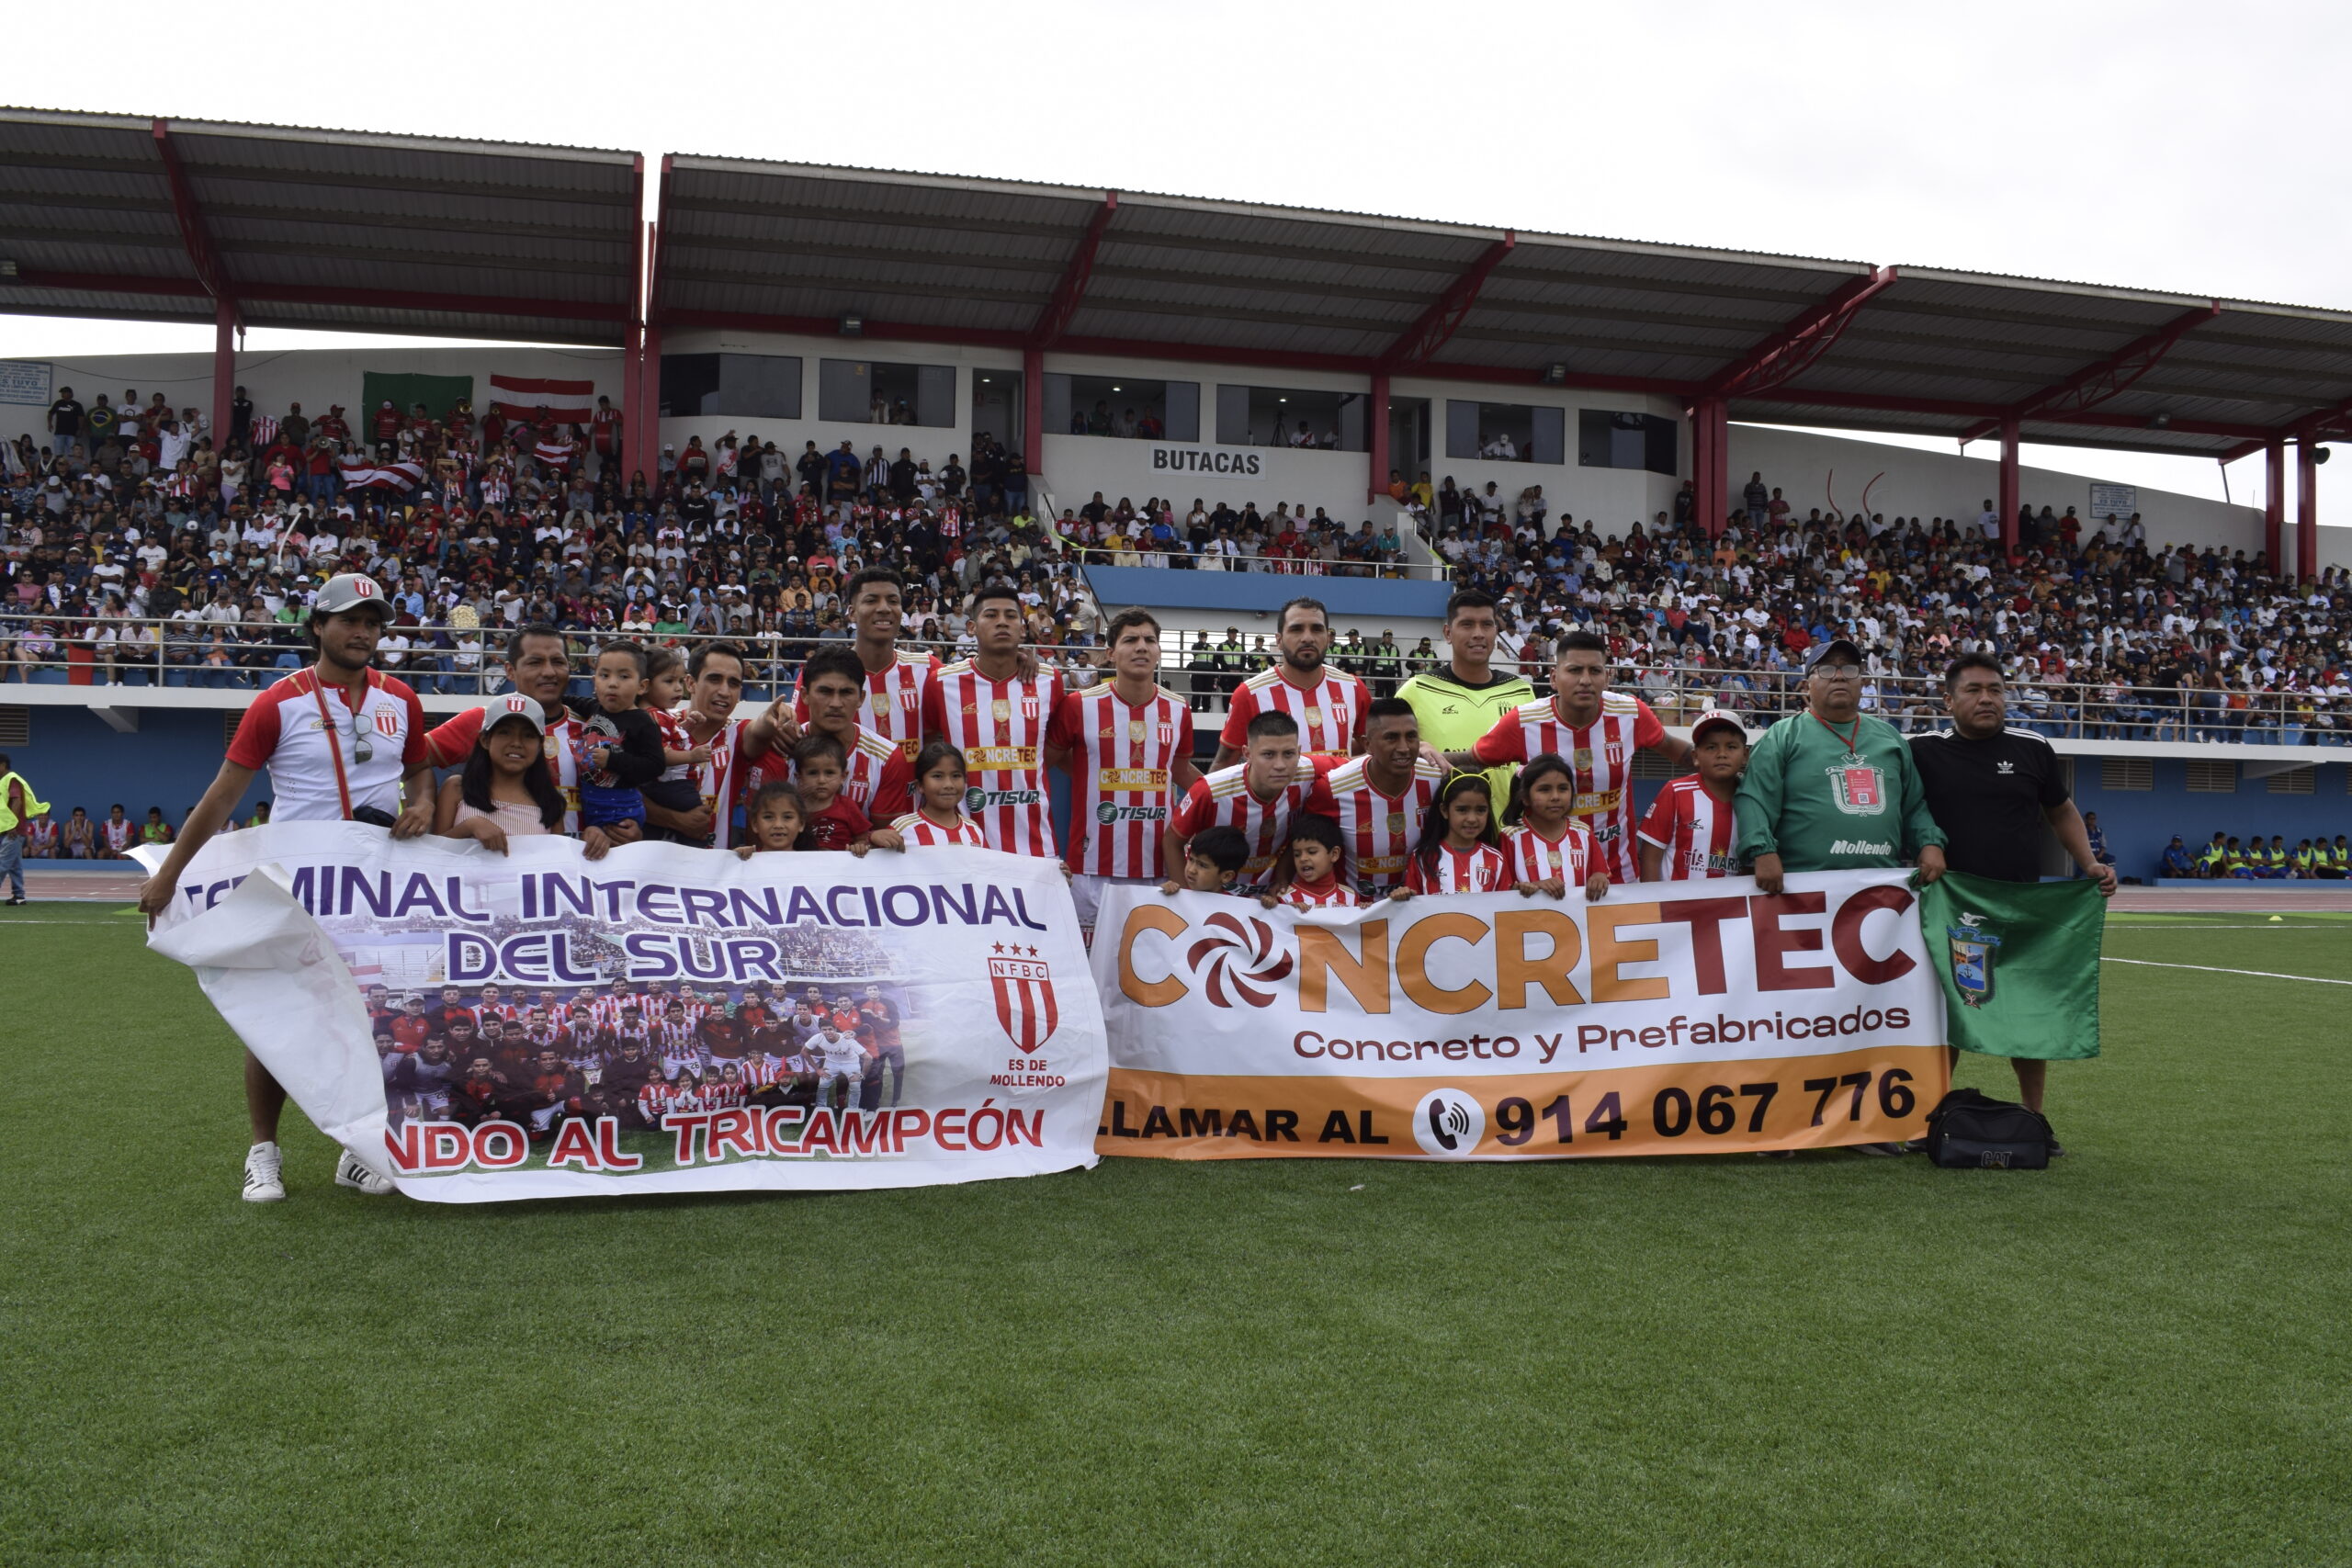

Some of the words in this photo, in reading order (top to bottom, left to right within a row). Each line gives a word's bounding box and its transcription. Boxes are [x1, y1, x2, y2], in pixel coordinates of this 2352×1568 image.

[1154, 449, 1260, 475] BUTACAS
[987, 791, 1040, 806] TISUR
[1119, 807, 1167, 820] TISUR
[1830, 840, 1892, 856] Mollendo
[185, 865, 488, 922] TEMINAL
[522, 872, 1047, 931] INTERNACIONAL
[448, 932, 597, 981] DEL
[625, 933, 785, 981] SUR
[1294, 1029, 1521, 1061] Concreto
[1534, 1033, 1563, 1064] y
[1577, 1004, 1911, 1053] Prefabricados
[1008, 1059, 1024, 1071] ES
[1029, 1059, 1047, 1071] DE
[989, 1074, 1066, 1087] MOLLENDO
[1317, 1110, 1390, 1145] AL
[1495, 1091, 1628, 1146] 914
[1654, 1082, 1779, 1137] 067
[1804, 1067, 1917, 1128] 776
[552, 1121, 639, 1168] AL
[666, 1098, 1046, 1162] TRICAMPEÓN
[1981, 1150, 2013, 1168] CAT
